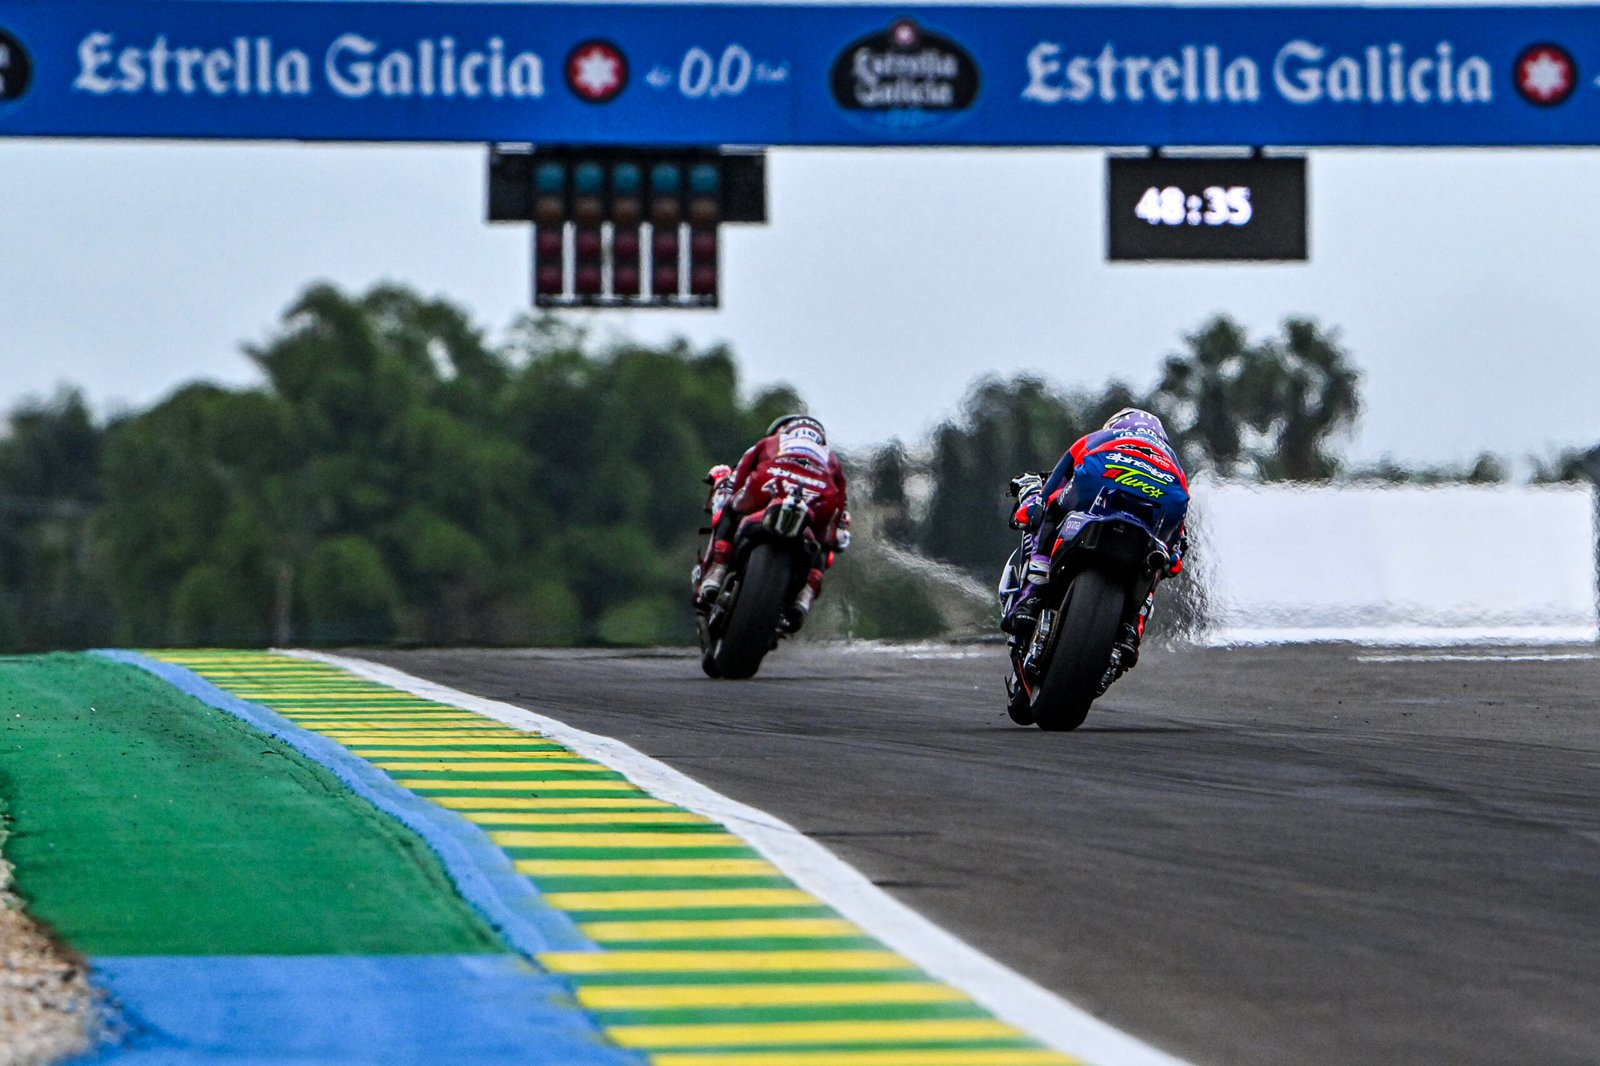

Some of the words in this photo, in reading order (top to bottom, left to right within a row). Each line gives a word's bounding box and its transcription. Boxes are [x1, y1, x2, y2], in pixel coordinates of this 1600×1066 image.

[75, 33, 310, 93] Estrella
[325, 35, 544, 96] Galicia
[1023, 42, 1259, 102] Estrella
[1274, 41, 1491, 102] Galicia
[1134, 186, 1253, 226] 48:35
